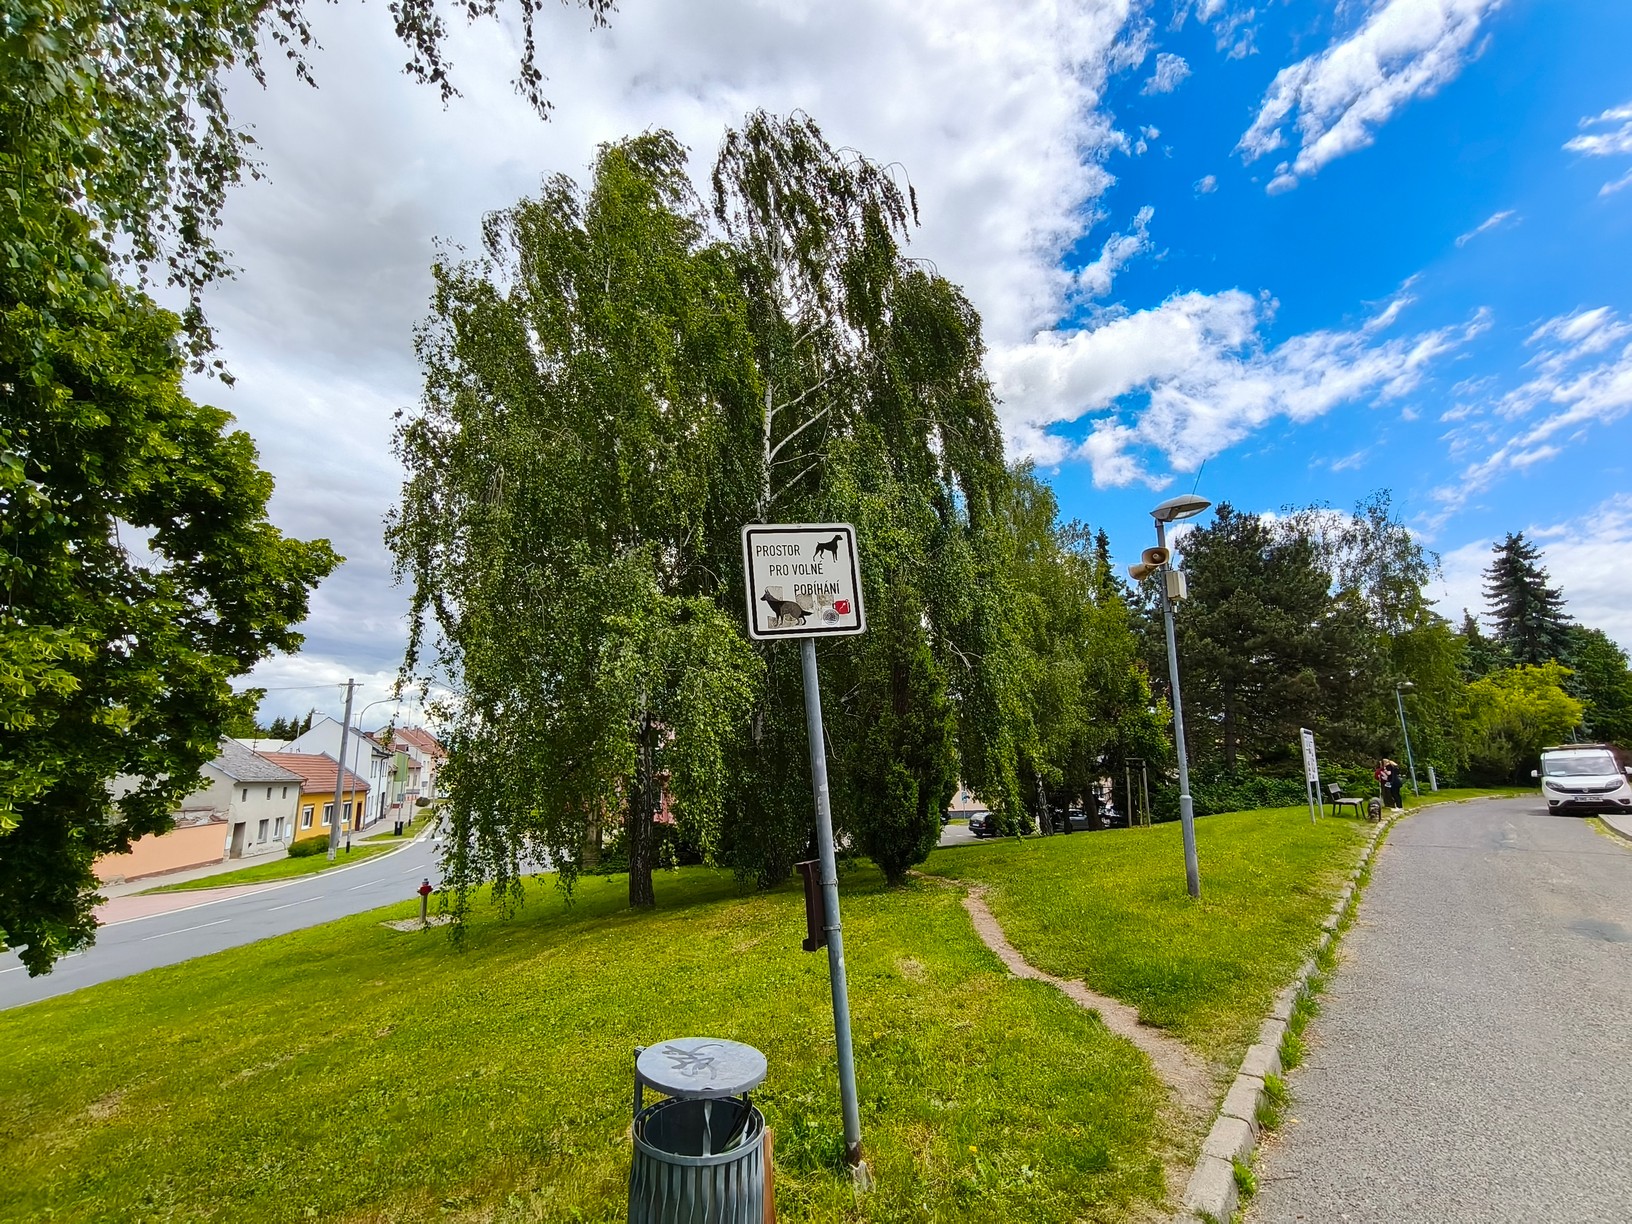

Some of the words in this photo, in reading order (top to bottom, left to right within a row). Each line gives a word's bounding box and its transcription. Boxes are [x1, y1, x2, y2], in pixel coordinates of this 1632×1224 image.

[756, 545, 800, 557] PROSTOR
[769, 564, 789, 576] PRO
[792, 560, 823, 575] VOLNÉ
[794, 580, 840, 595] POBÍHÁNÍ
